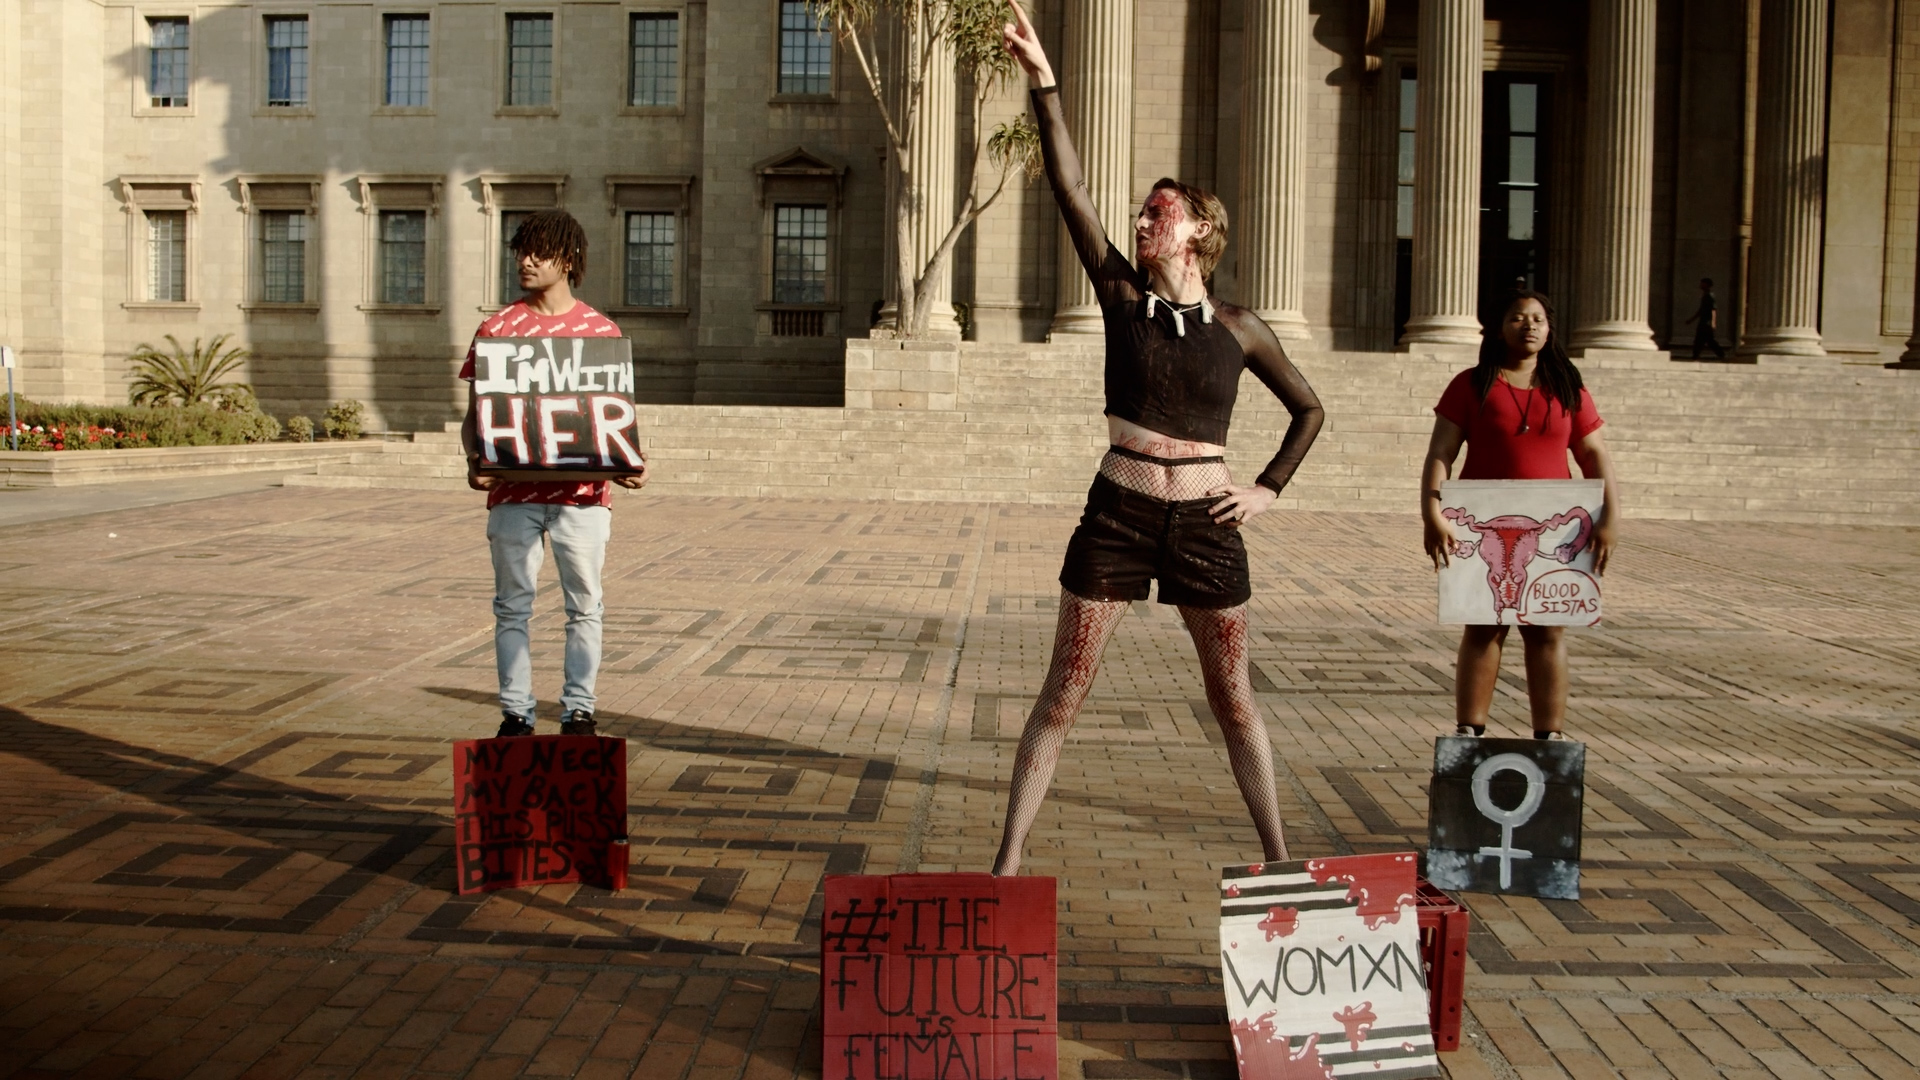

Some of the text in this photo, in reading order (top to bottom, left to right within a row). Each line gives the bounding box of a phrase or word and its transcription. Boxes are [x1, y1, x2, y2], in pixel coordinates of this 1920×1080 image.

[481, 396, 645, 467] HER
[1532, 598, 1598, 616] SISTAS
[1533, 583, 1580, 599] BLOOD
[464, 738, 621, 777] MY NECK
[460, 775, 616, 815] MY BACK
[456, 809, 534, 841] THIS
[460, 839, 573, 890] BITES
[824, 897, 1007, 953] #THE
[831, 952, 1047, 1020] FUTURE
[1222, 939, 1426, 1008] WOMXN
[916, 1016, 955, 1039] IS
[843, 1028, 1046, 1080] FEMALE
